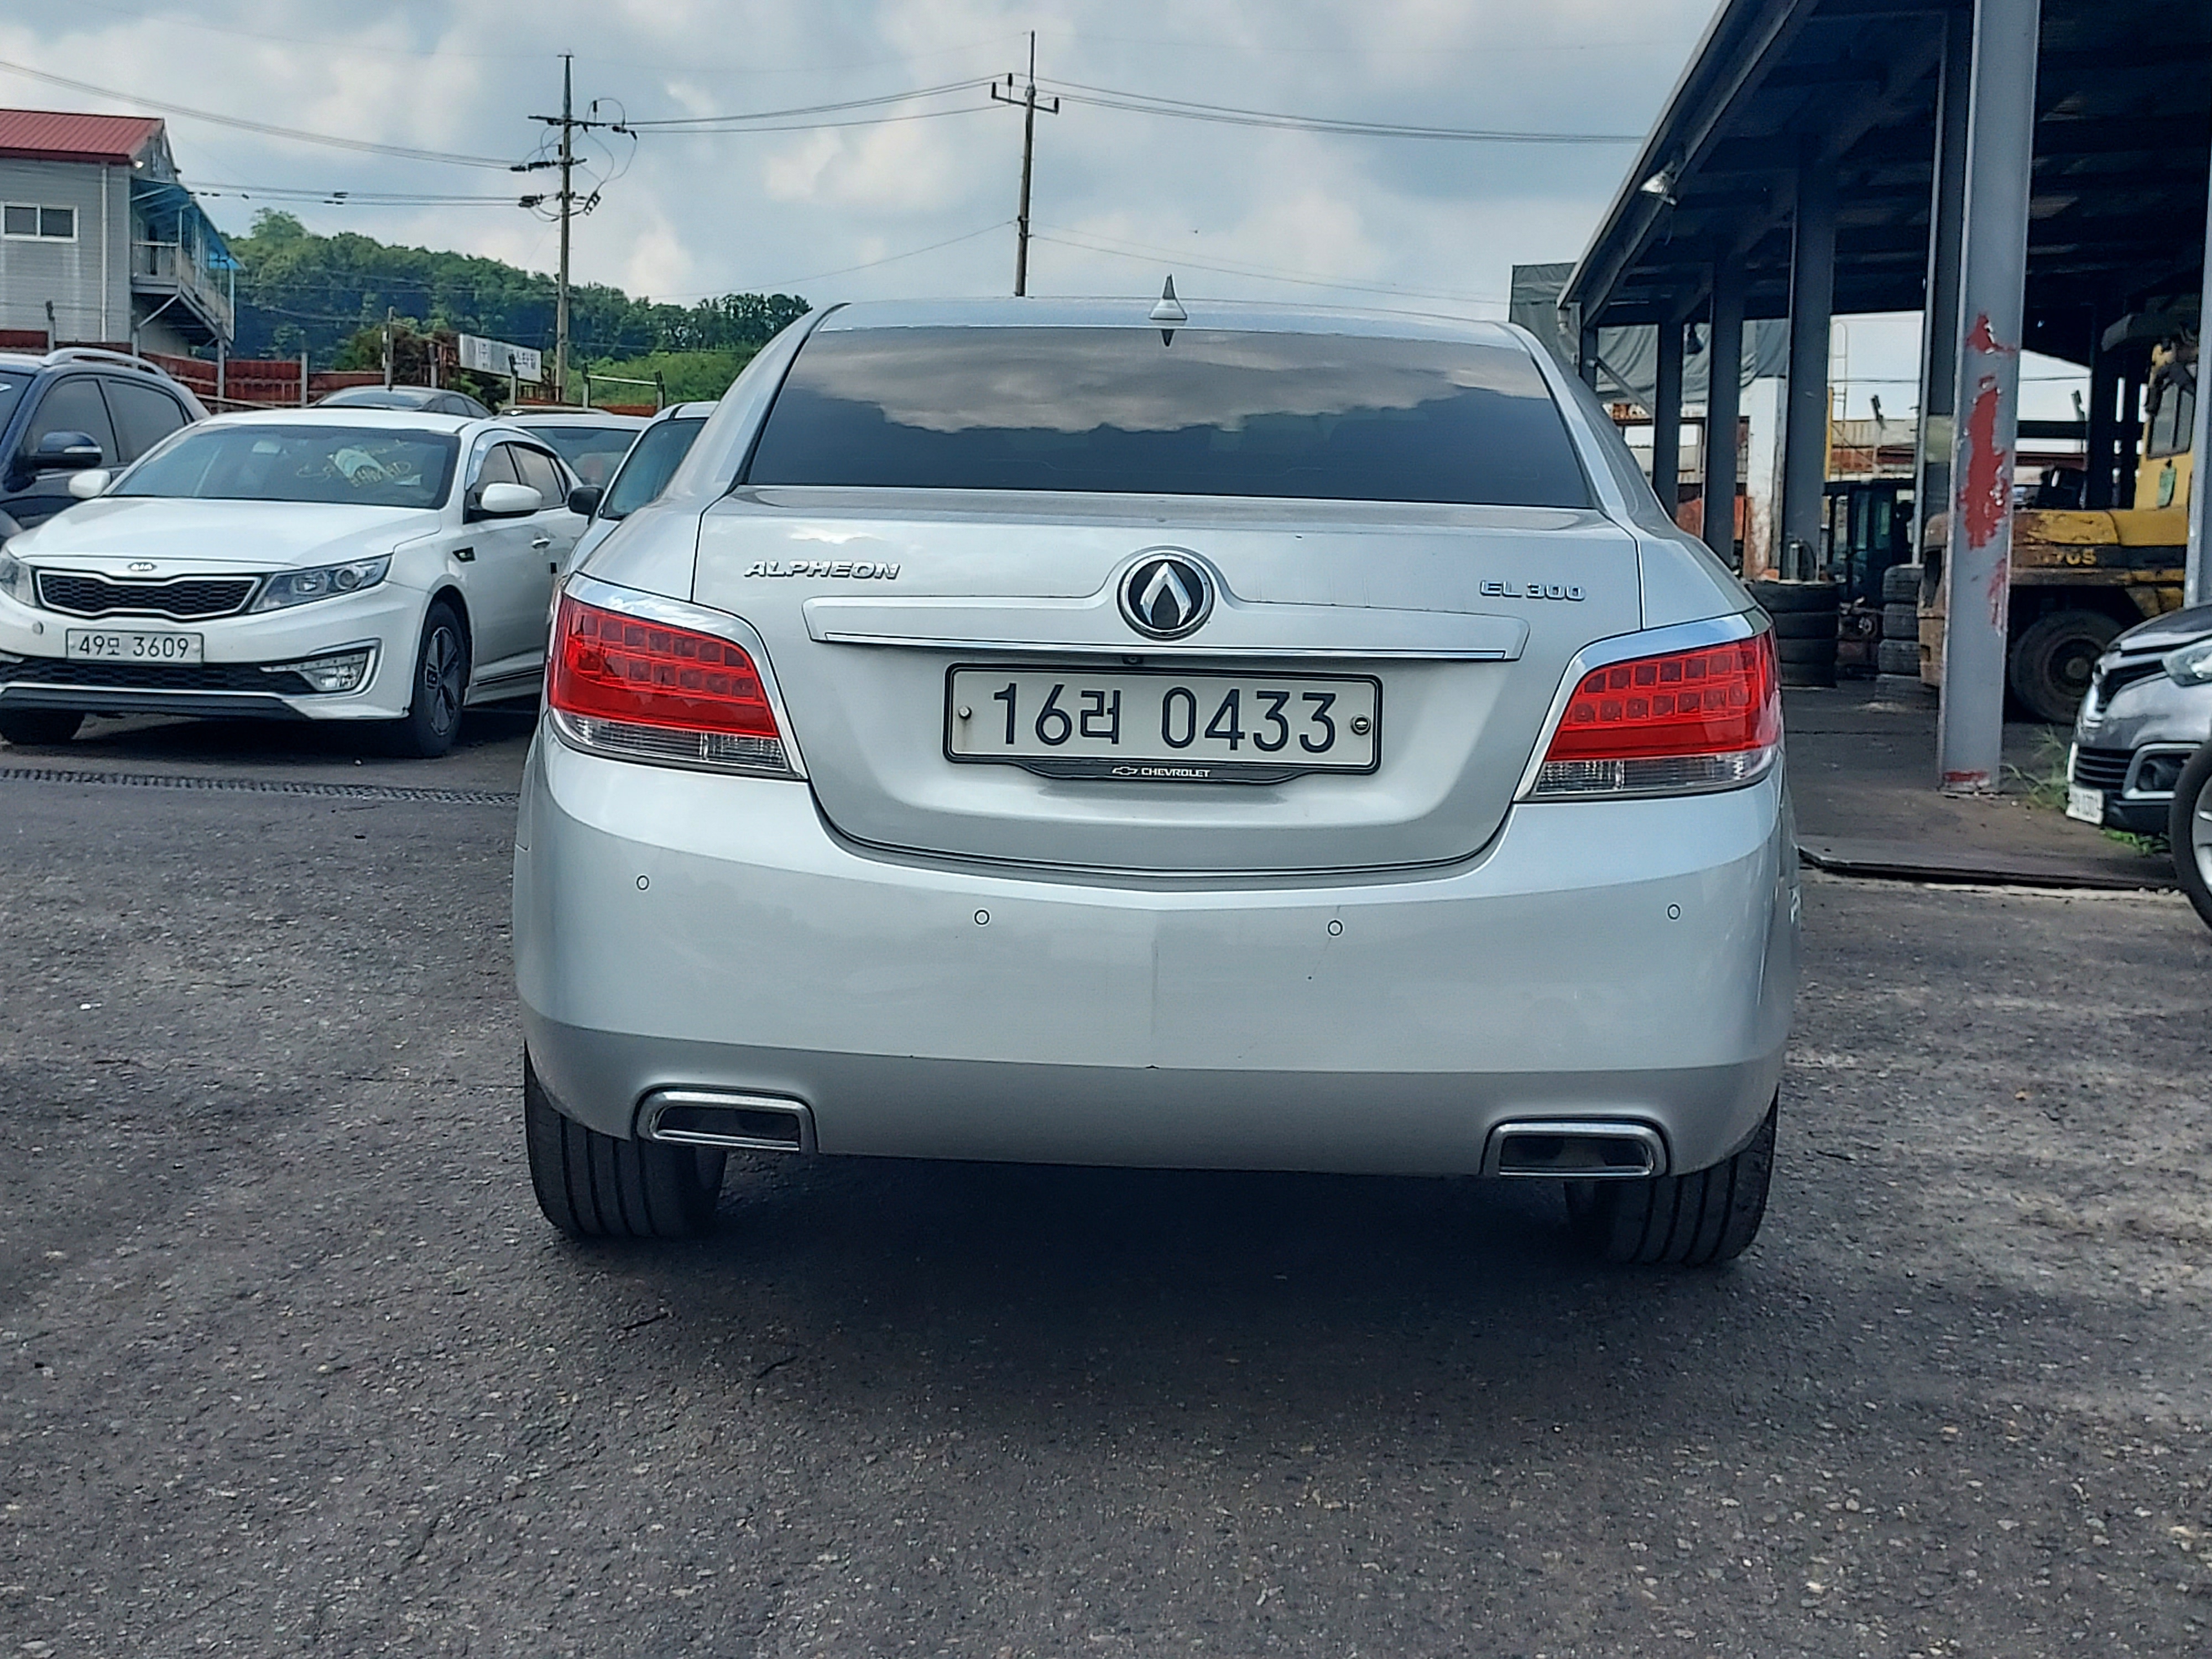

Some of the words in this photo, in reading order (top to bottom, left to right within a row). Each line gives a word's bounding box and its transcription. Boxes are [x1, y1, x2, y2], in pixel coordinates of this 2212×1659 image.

[744, 561, 900, 579] ALPHEON
[79, 634, 121, 655] 49모
[133, 637, 189, 659] 3609
[994, 682, 1121, 746] 16러
[1161, 686, 1337, 754] 0433
[1141, 768, 1211, 778] CHEVROLET
